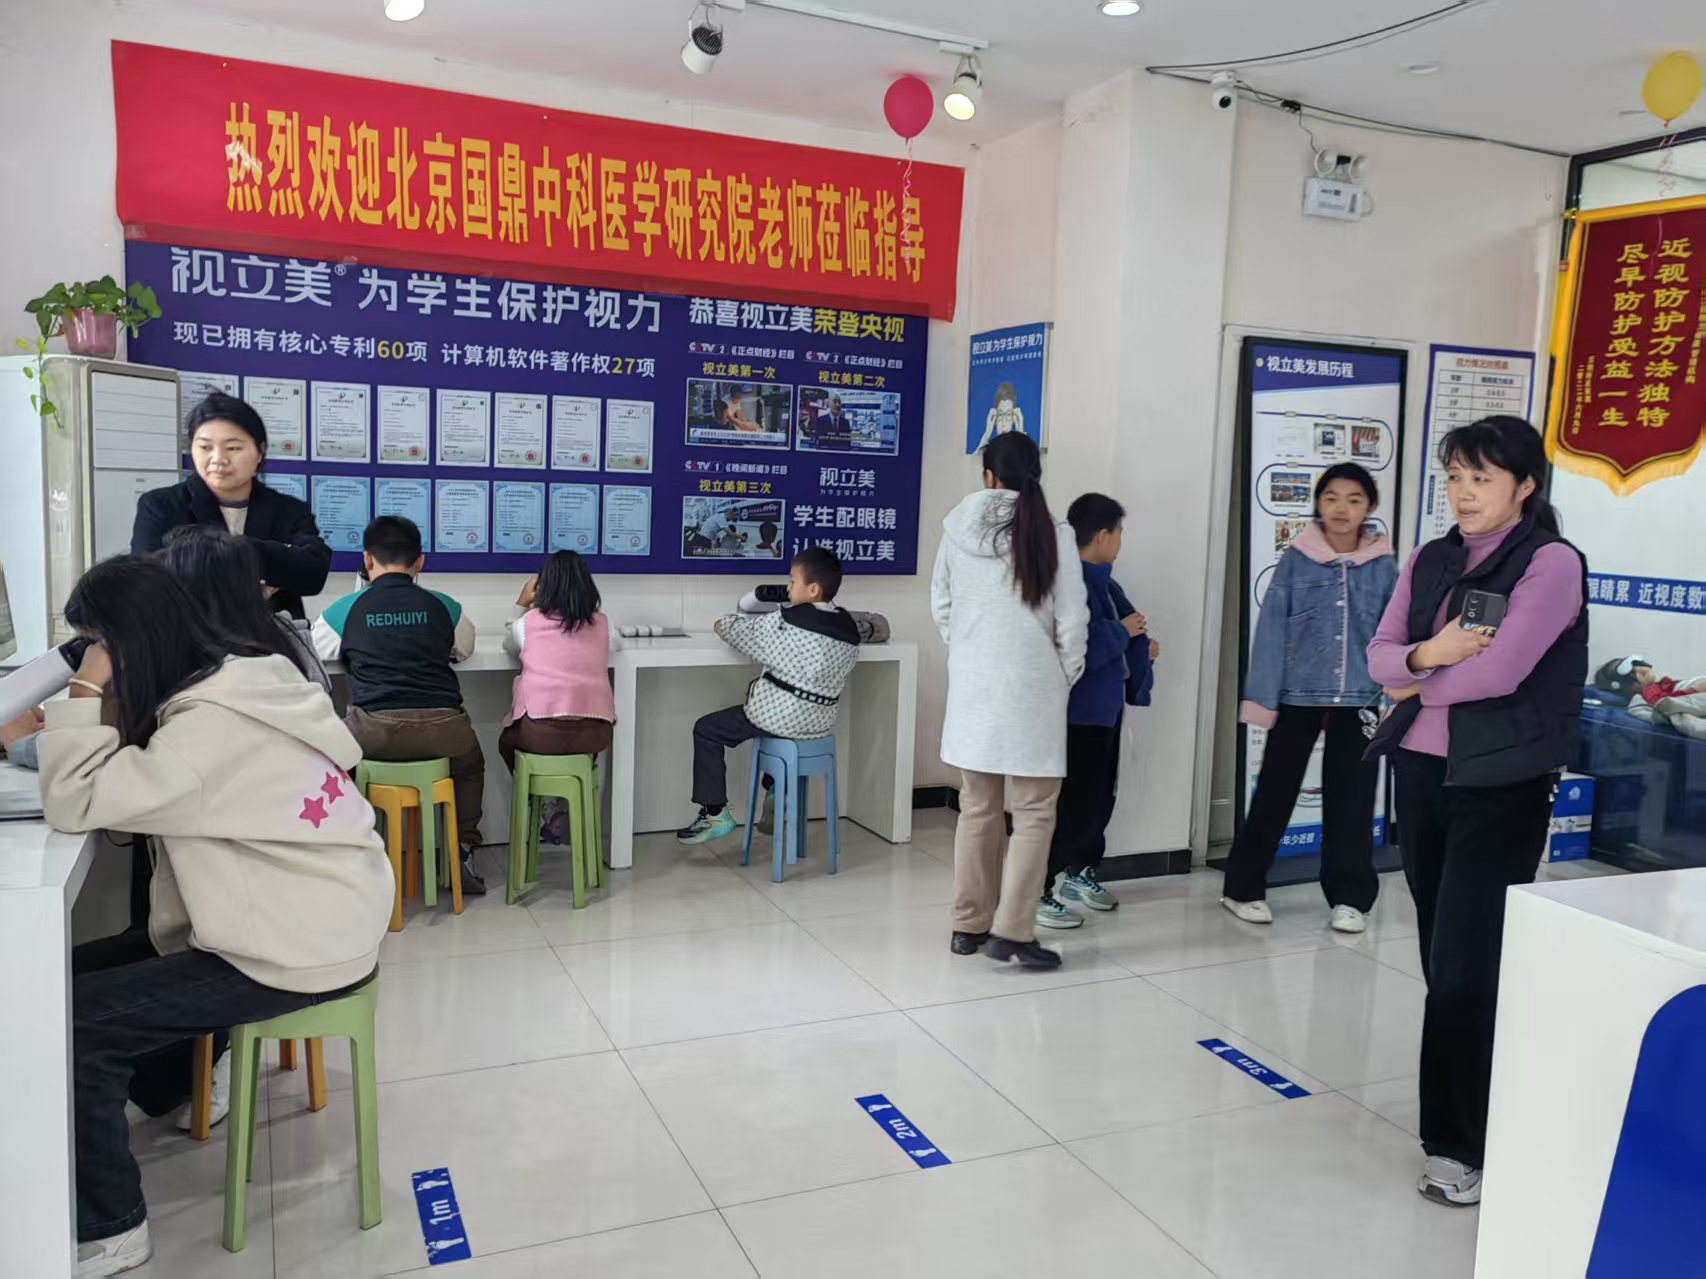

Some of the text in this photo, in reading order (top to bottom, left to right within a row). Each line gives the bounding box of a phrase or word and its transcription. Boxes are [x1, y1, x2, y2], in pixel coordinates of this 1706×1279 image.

[225, 102, 925, 283] 热烈欢迎北京国鼎中科医学研究院老师莅临指导
[358, 268, 661, 333] 为学生保护视力
[689, 297, 905, 343] 恭喜视立美荣登央视
[1598, 243, 1649, 427] 尽早防护受益一生
[1636, 237, 1692, 428] 近视防护方法独特
[173, 320, 656, 378] 现已拥有核心专利60项 计算机软件著作权27项
[702, 361, 776, 379] 视立美第一次
[1267, 355, 1354, 378] 视立美发展历程
[818, 370, 885, 388] 视立美第二次
[699, 479, 772, 494] 视立美第三次
[819, 467, 876, 488] 视立美
[793, 505, 897, 530] 学生配眼镜
[366, 611, 428, 628] REDHUIYI
[1237, 1058, 1268, 1075] 3m
[889, 1118, 918, 1139] 2m
[429, 1199, 452, 1225] 1m
